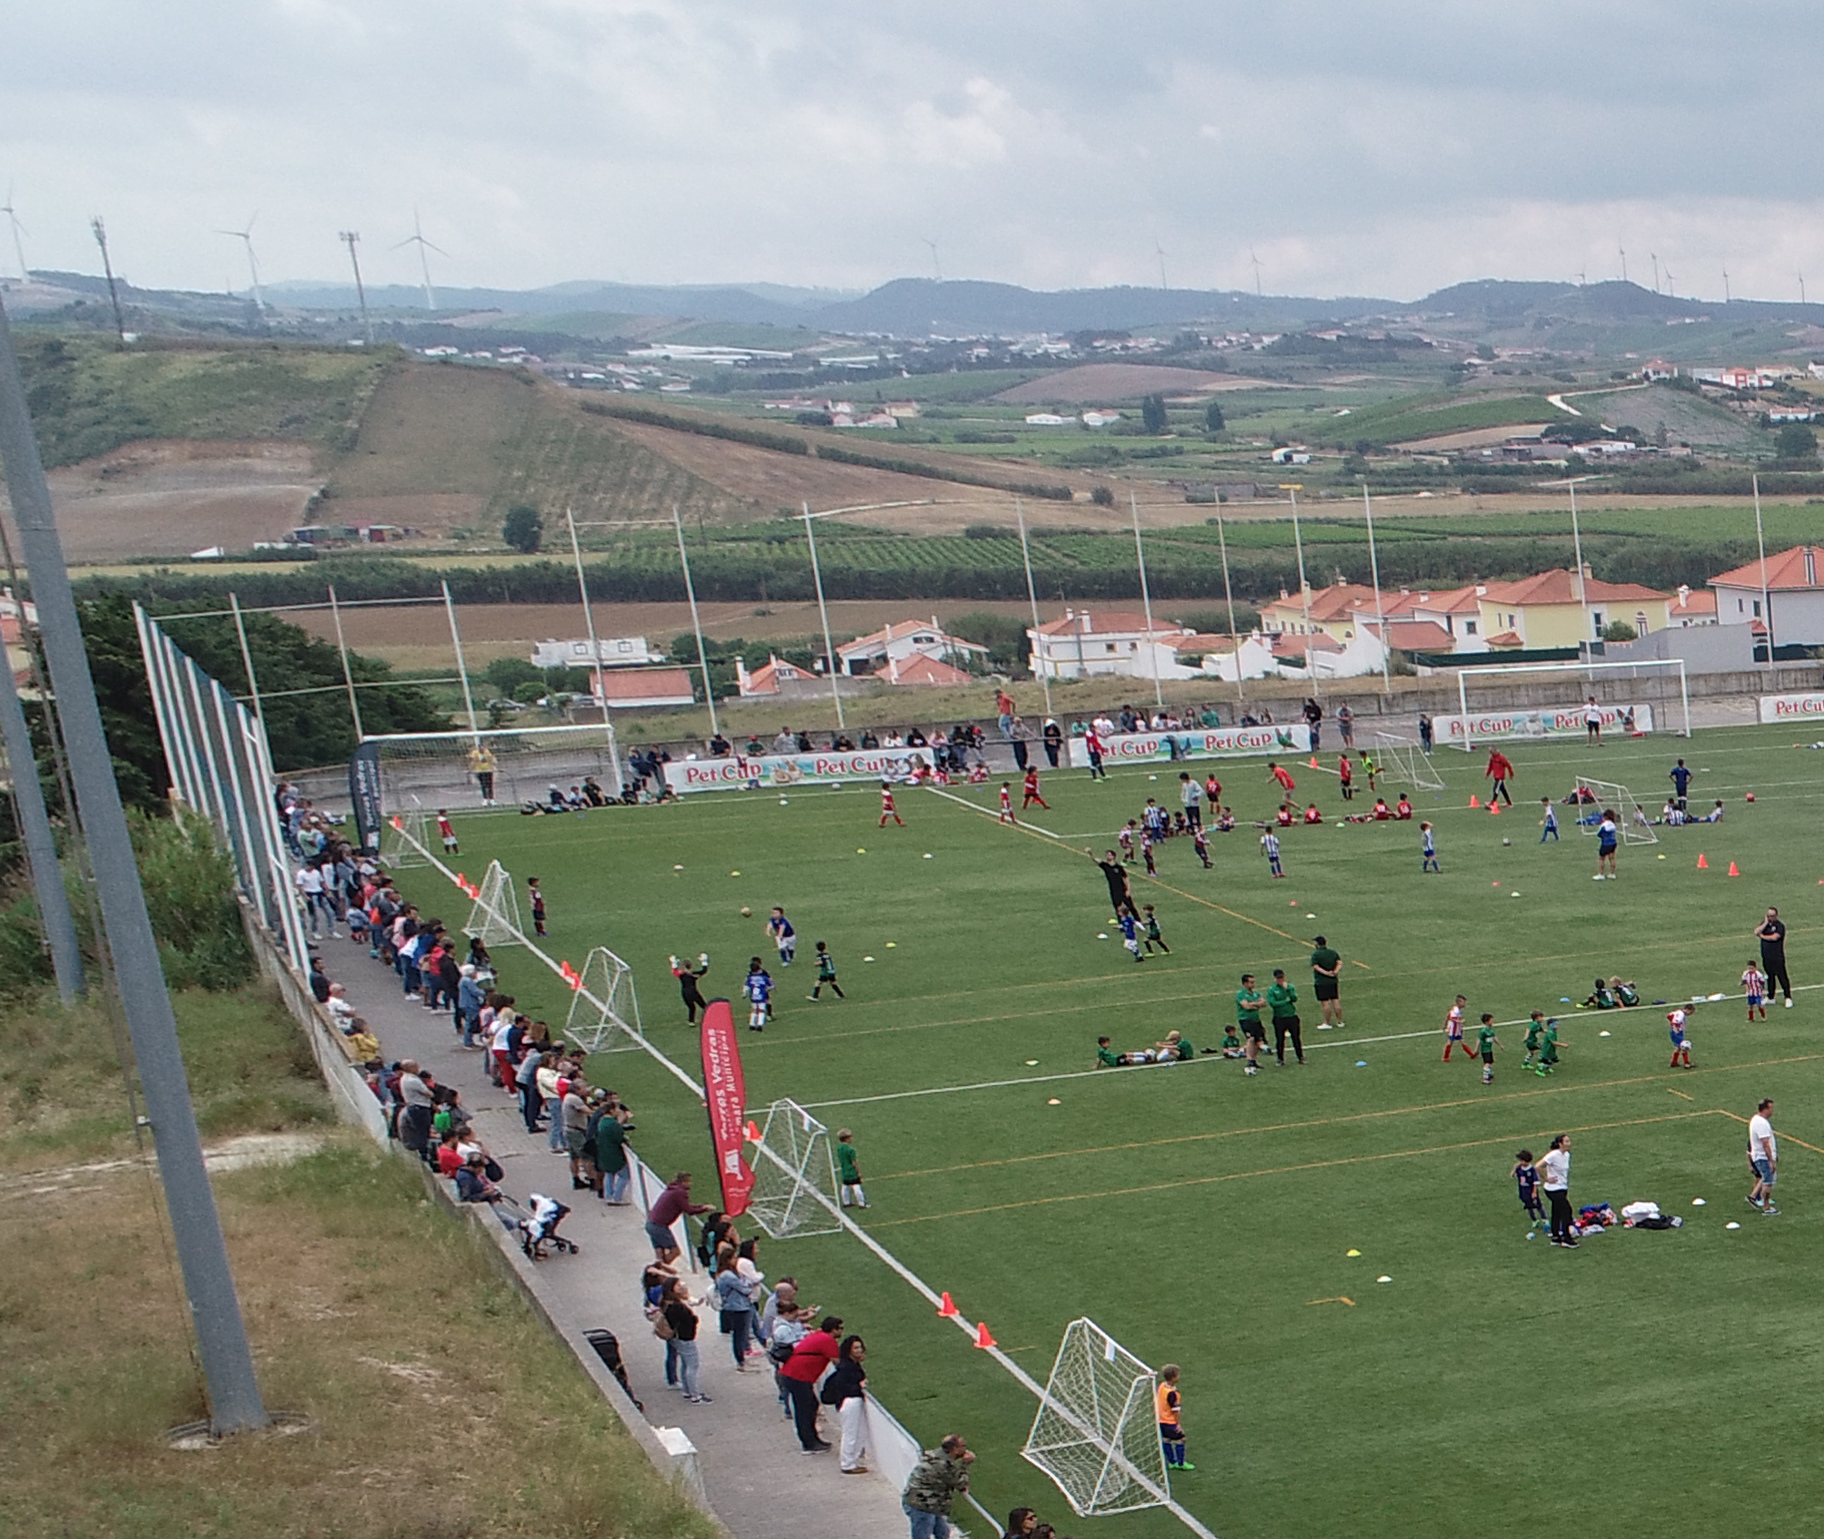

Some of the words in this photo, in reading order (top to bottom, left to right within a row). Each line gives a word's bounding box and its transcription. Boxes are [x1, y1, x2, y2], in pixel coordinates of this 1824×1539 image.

[1776, 701, 1799, 714] Pet
[1479, 718, 1513, 732] Cup
[1555, 715, 1580, 729] Pet
[1121, 739, 1158, 756] Cup
[1205, 734, 1232, 750] Pet
[1236, 733, 1273, 748] Cup
[815, 758, 847, 774] Pet
[686, 767, 717, 783] Pet
[707, 1028, 722, 1084] Vedras
[718, 1029, 737, 1092] Municipal
